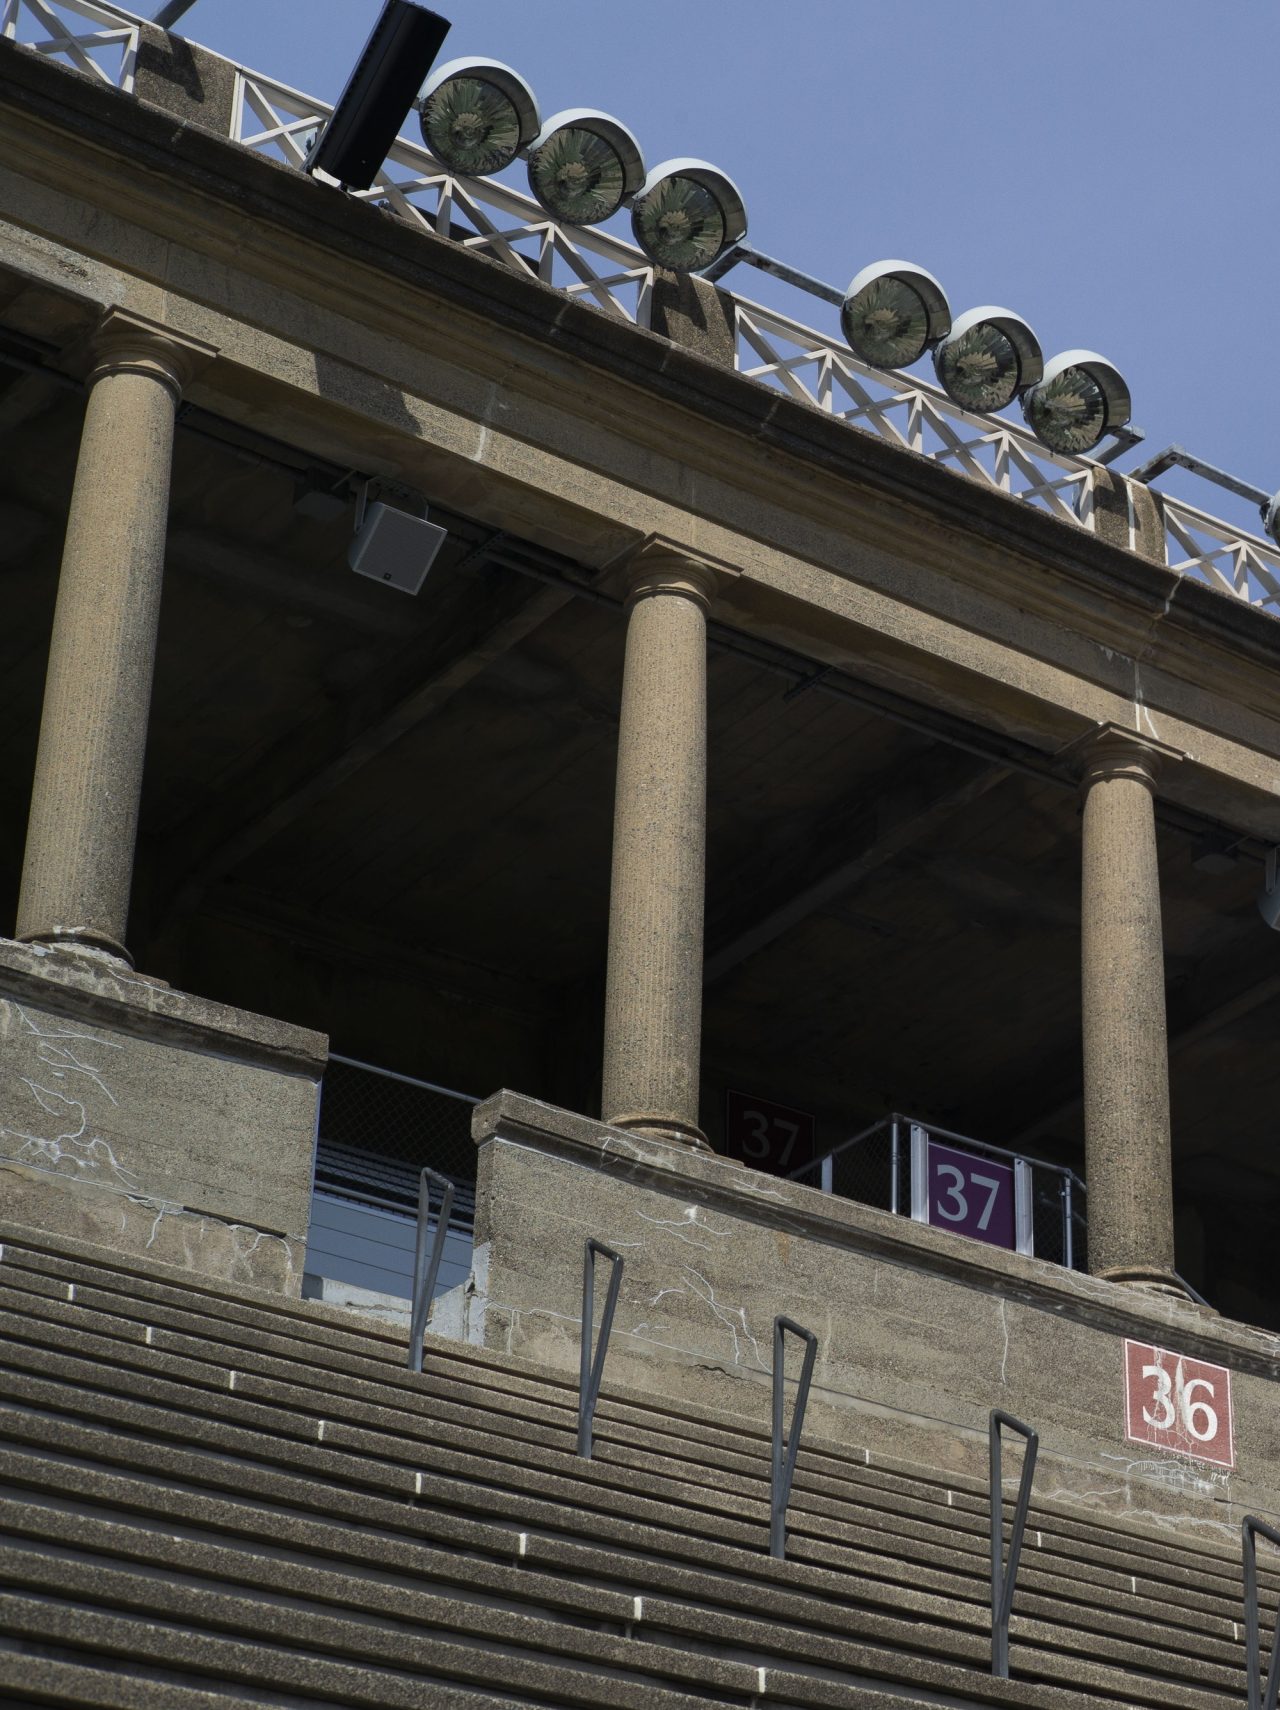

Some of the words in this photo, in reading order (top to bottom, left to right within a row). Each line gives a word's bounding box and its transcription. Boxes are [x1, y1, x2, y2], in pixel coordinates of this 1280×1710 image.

[742, 1110, 801, 1167] 37
[936, 1164, 1000, 1231] 37
[1142, 1365, 1218, 1442] 36
